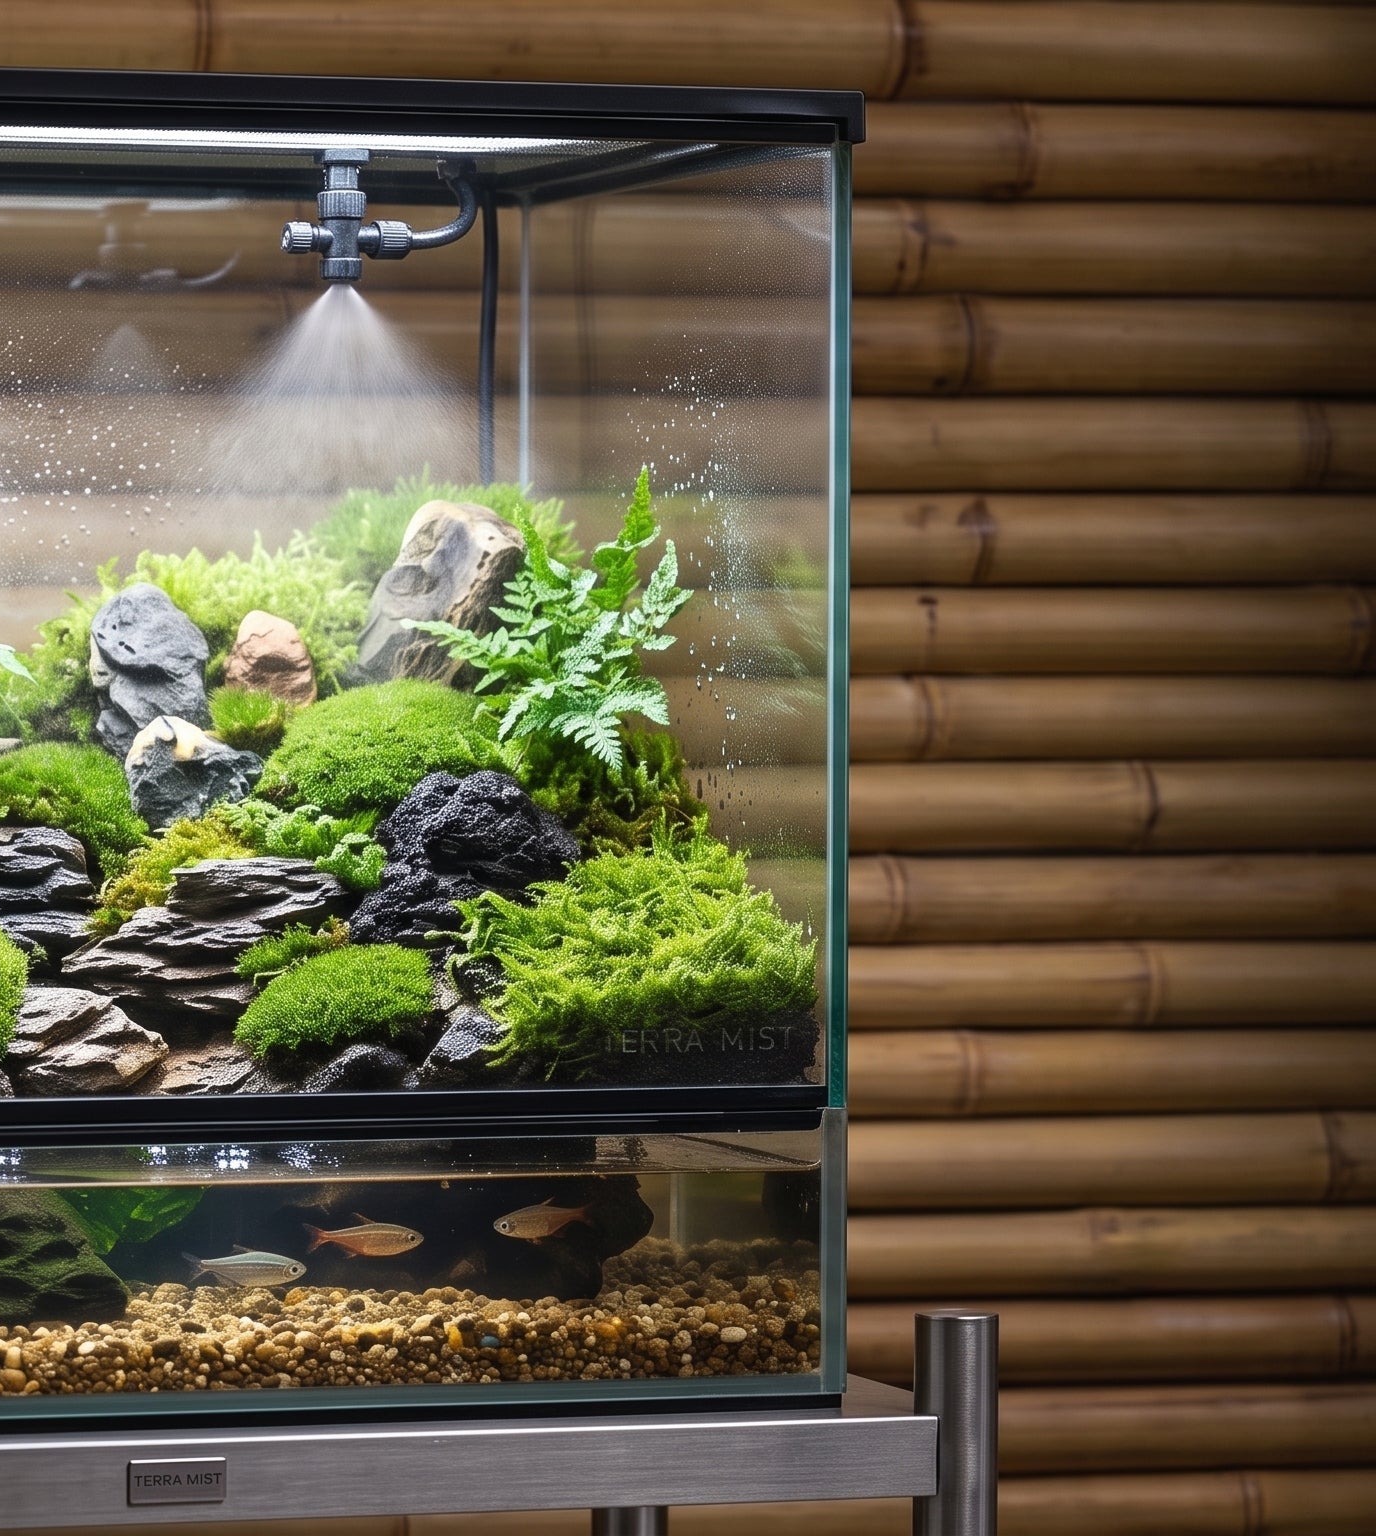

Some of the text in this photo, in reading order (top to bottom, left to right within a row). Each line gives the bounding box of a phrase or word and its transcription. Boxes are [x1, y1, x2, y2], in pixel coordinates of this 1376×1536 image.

[721, 1026, 793, 1051] MIST
[134, 1473, 222, 1487] TERRA MIST
